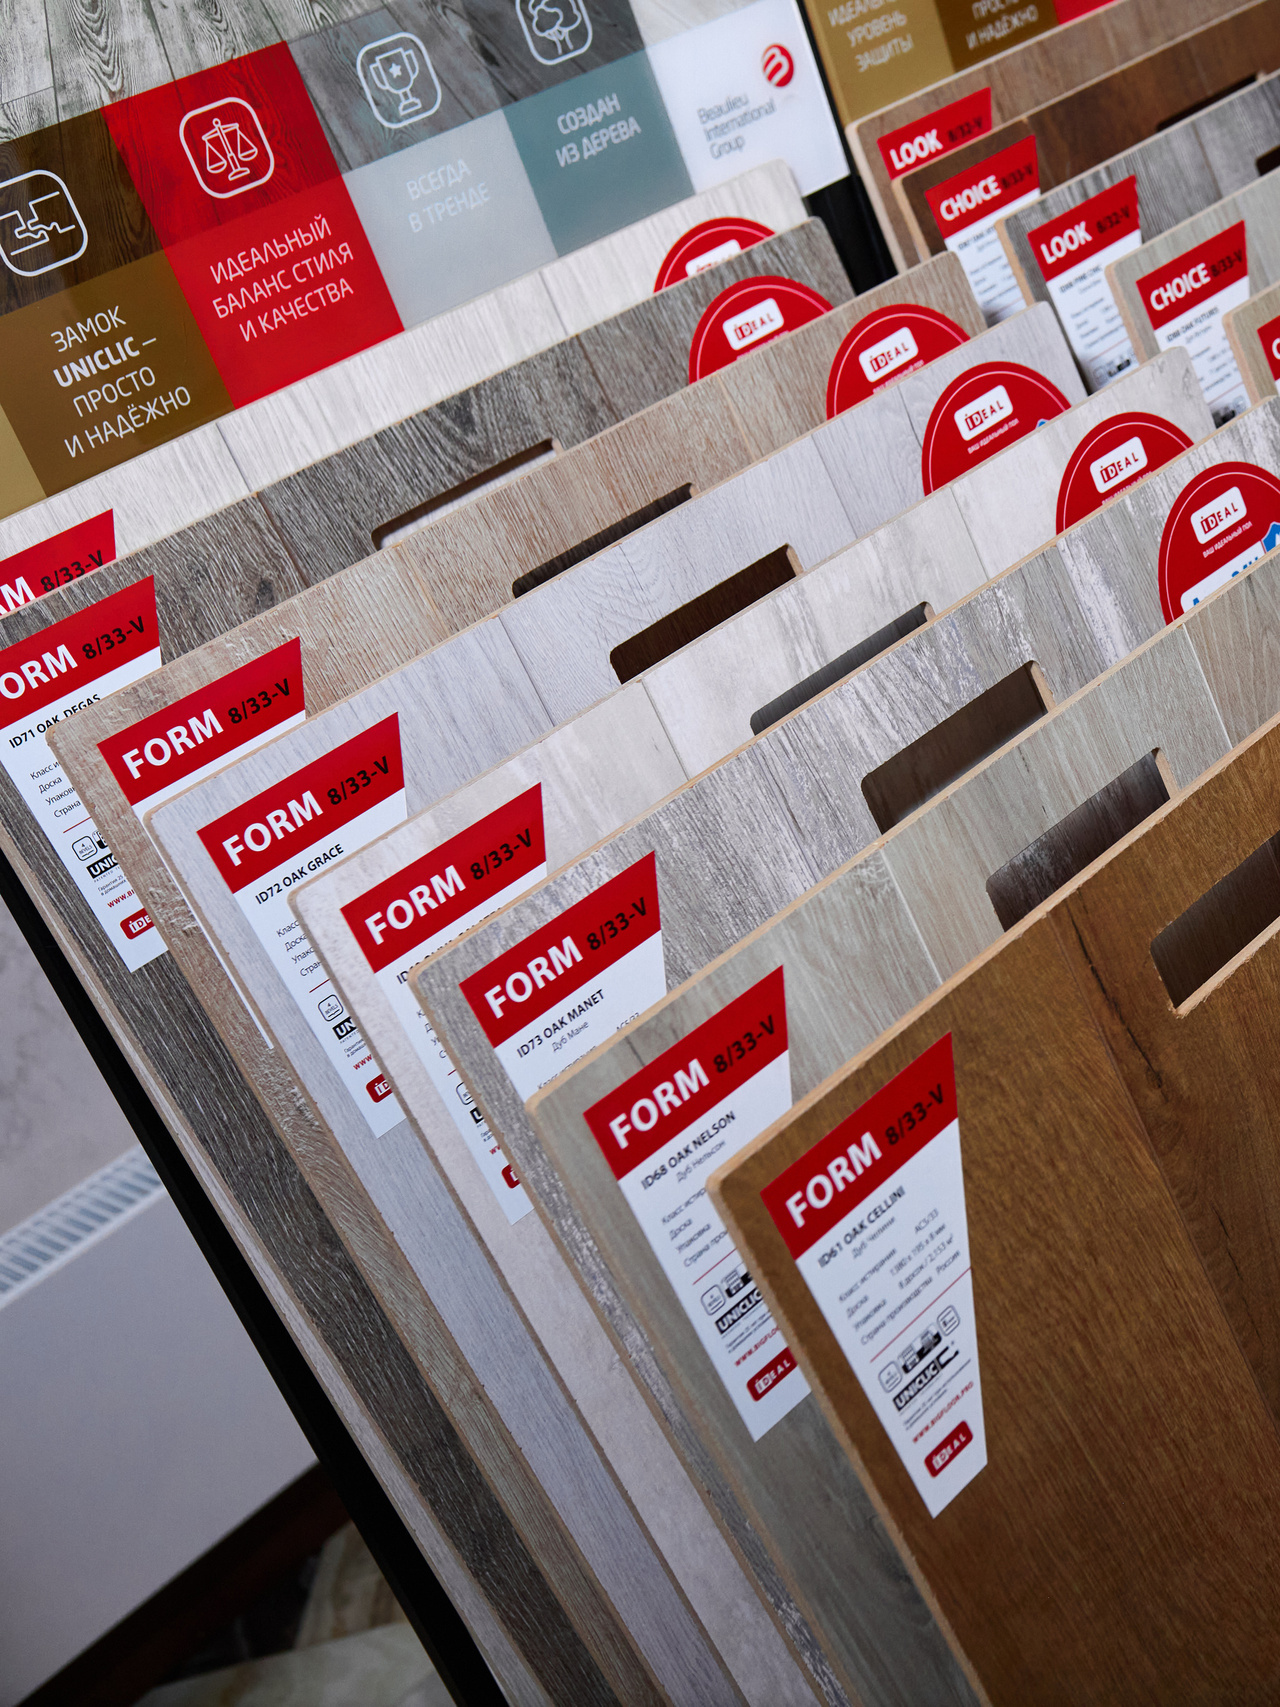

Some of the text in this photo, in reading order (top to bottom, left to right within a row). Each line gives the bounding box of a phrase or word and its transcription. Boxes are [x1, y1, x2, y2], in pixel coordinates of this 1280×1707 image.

[855, 34, 913, 72] ЗАЩИТЫ
[966, 32, 979, 50] И
[556, 94, 621, 135] СОЗДАН
[696, 91, 750, 124] Beaulieu
[702, 98, 775, 142] International
[555, 117, 642, 168] ИЗ ДЕРЕВА
[709, 136, 746, 161] Group
[889, 129, 943, 170] LOOK
[406, 159, 471, 200] ВСЕГДА
[939, 175, 1002, 221] CHOICE
[409, 182, 490, 233] В ТРЕНДЕ
[210, 213, 332, 284] ИДЕАЛЬНЫЙ
[1040, 221, 1093, 265] LOOK
[212, 242, 354, 319] БАЛАНС СТИЛЯ
[1149, 263, 1211, 311] CHOICE
[50, 306, 127, 353] ЗАМОК
[239, 278, 354, 343] И КАЧЕСТВА
[53, 337, 140, 388] UNICLIC
[72, 366, 156, 418] ПРОСТО
[64, 386, 191, 458] И НАДЁЖНО
[1202, 520, 1253, 560] ВАШ ИДЕАЛЬНЫЙ ПОЛ
[40, 550, 104, 592] 8/33-V
[0, 616, 145, 699] ORM 8/33-V
[9, 729, 36, 749] ID71
[36, 715, 61, 734] OAK
[122, 678, 290, 780] FORM 8/33-V
[30, 764, 53, 780] Класс
[38, 776, 63, 794] Доска
[45, 786, 75, 806] Упаков
[54, 800, 81, 818] Страна
[222, 756, 389, 867] FORM 8/33-V
[90, 855, 118, 876] UNIC
[255, 843, 344, 905] ID72 OAK GRACE
[364, 865, 466, 946] FORM
[470, 828, 532, 880] 8/33-V
[483, 935, 584, 1019] FORM
[586, 897, 647, 951] 8/33-V
[517, 989, 605, 1058] ID73 OAK MANET
[551, 1021, 589, 1052] Дуб Мане
[609, 1058, 710, 1150] FORM
[713, 1014, 775, 1074] 8/33-V
[640, 1110, 736, 1190] ID68 OAK NELSON
[676, 1140, 726, 1184] Дуб Нельсон
[786, 1083, 944, 1229] FORM 8/33-V
[662, 1206, 684, 1225] Класс
[669, 1218, 693, 1241] Доска
[818, 1185, 906, 1268] ID61 OAK CELLINI
[683, 1244, 710, 1267] Страна
[717, 1289, 763, 1332] UNICLIC
[895, 1360, 938, 1406] UNICLIC
